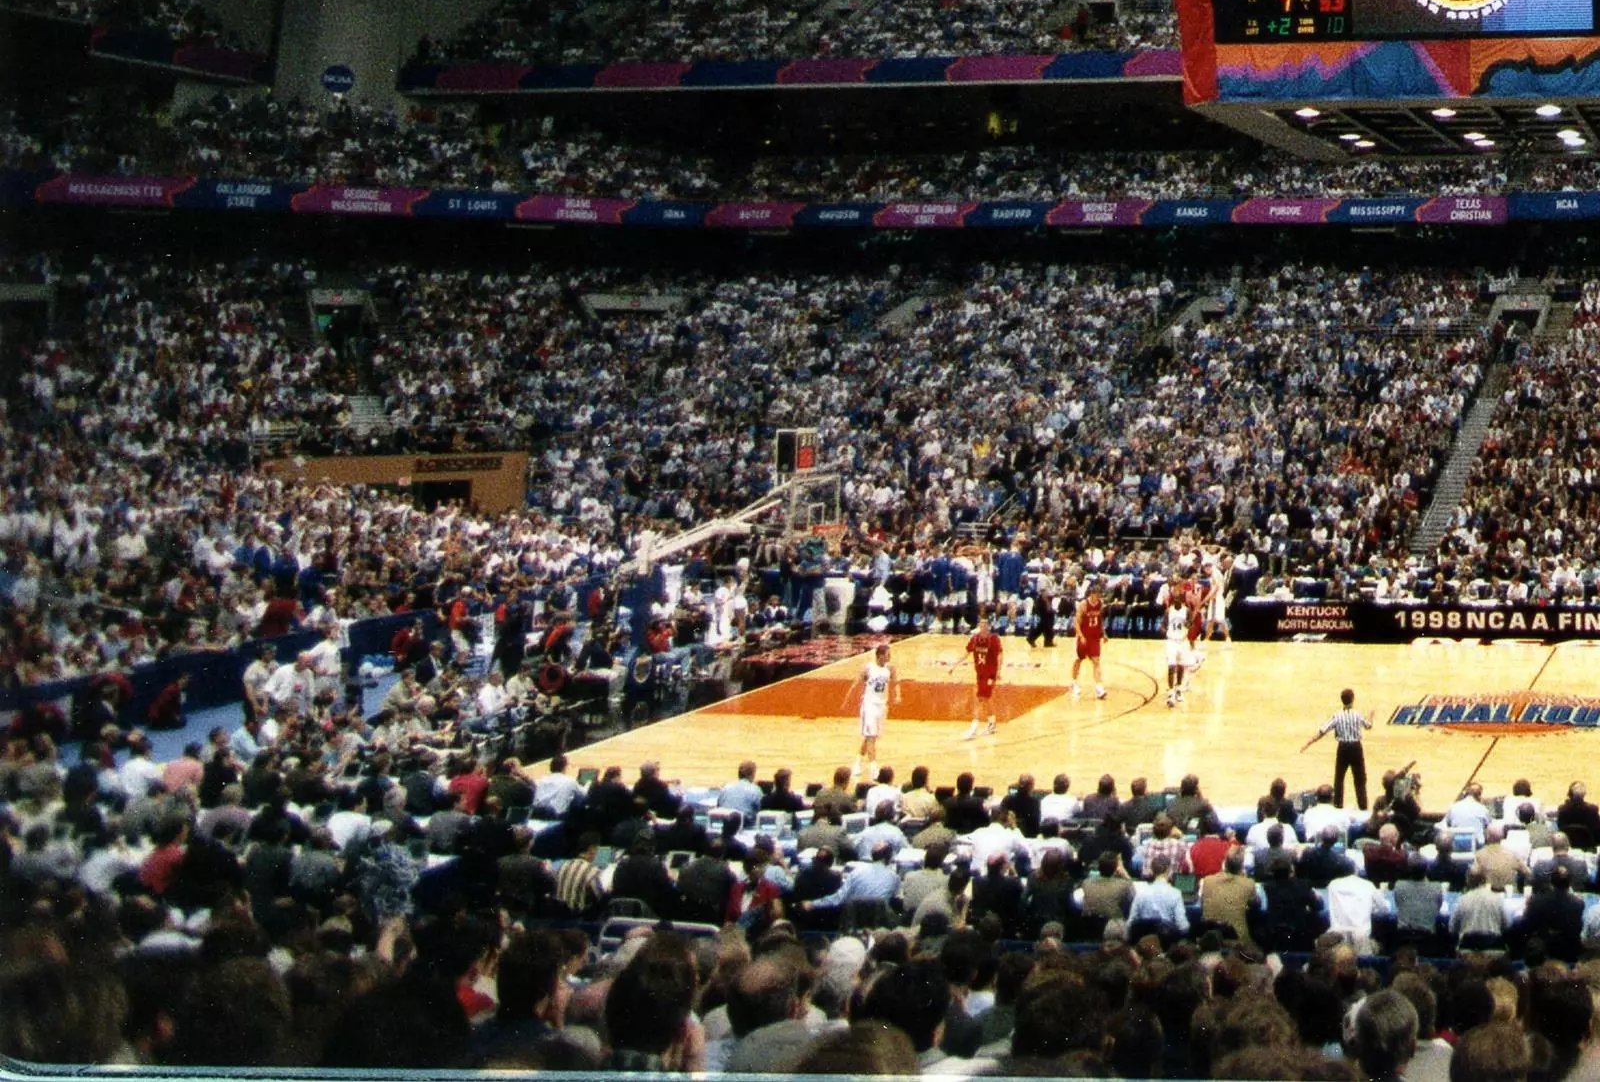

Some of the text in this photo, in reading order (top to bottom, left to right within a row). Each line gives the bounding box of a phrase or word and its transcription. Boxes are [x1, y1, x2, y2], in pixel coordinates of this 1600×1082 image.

[68, 182, 163, 198] MASSACHUSETTS
[467, 199, 498, 211] LOUIS
[1455, 198, 1482, 209] TEXAS
[1555, 198, 1579, 210] NCAA
[991, 208, 1032, 219] RADFORD
[1175, 206, 1208, 217] KANSAS
[1269, 205, 1302, 216] PURDUE
[1349, 205, 1407, 216] MISSISSIPPI
[1450, 209, 1493, 221] CHRISTIAN
[1286, 606, 1348, 618] KENTUCKY
[1277, 619, 1354, 631] NORTH CAROLINA
[1394, 611, 1461, 630] 1998
[1466, 611, 1549, 631] NCAA
[1390, 704, 1513, 726] FINAL
